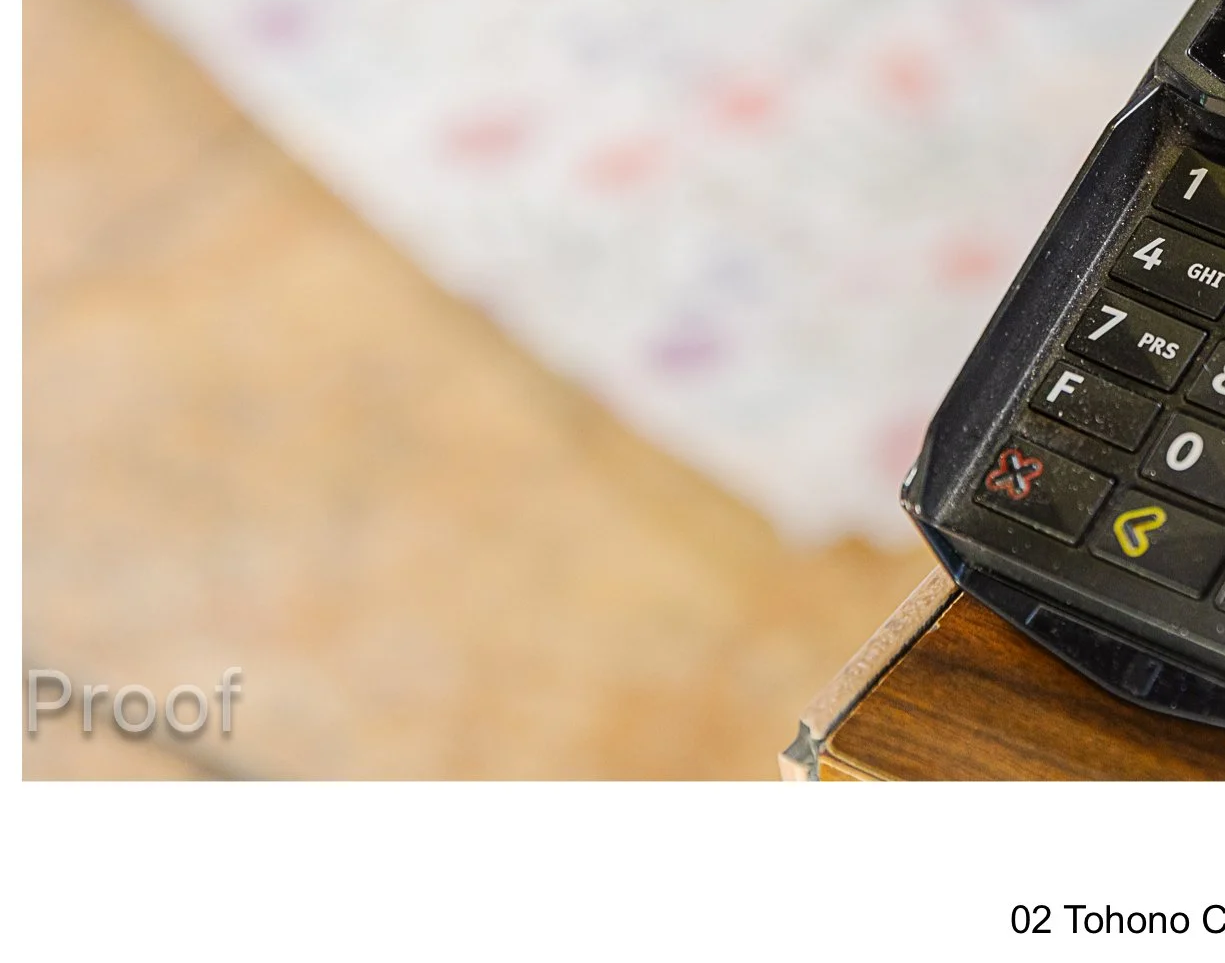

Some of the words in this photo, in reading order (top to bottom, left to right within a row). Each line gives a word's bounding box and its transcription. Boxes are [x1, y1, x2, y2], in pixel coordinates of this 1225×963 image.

[1183, 167, 1209, 200] 1
[1132, 237, 1163, 271] 4
[1187, 263, 1225, 289] GHI
[1087, 305, 1128, 341] 7
[1137, 332, 1180, 360] PRS
[1046, 370, 1085, 403] F
[1165, 431, 1204, 471] 0
